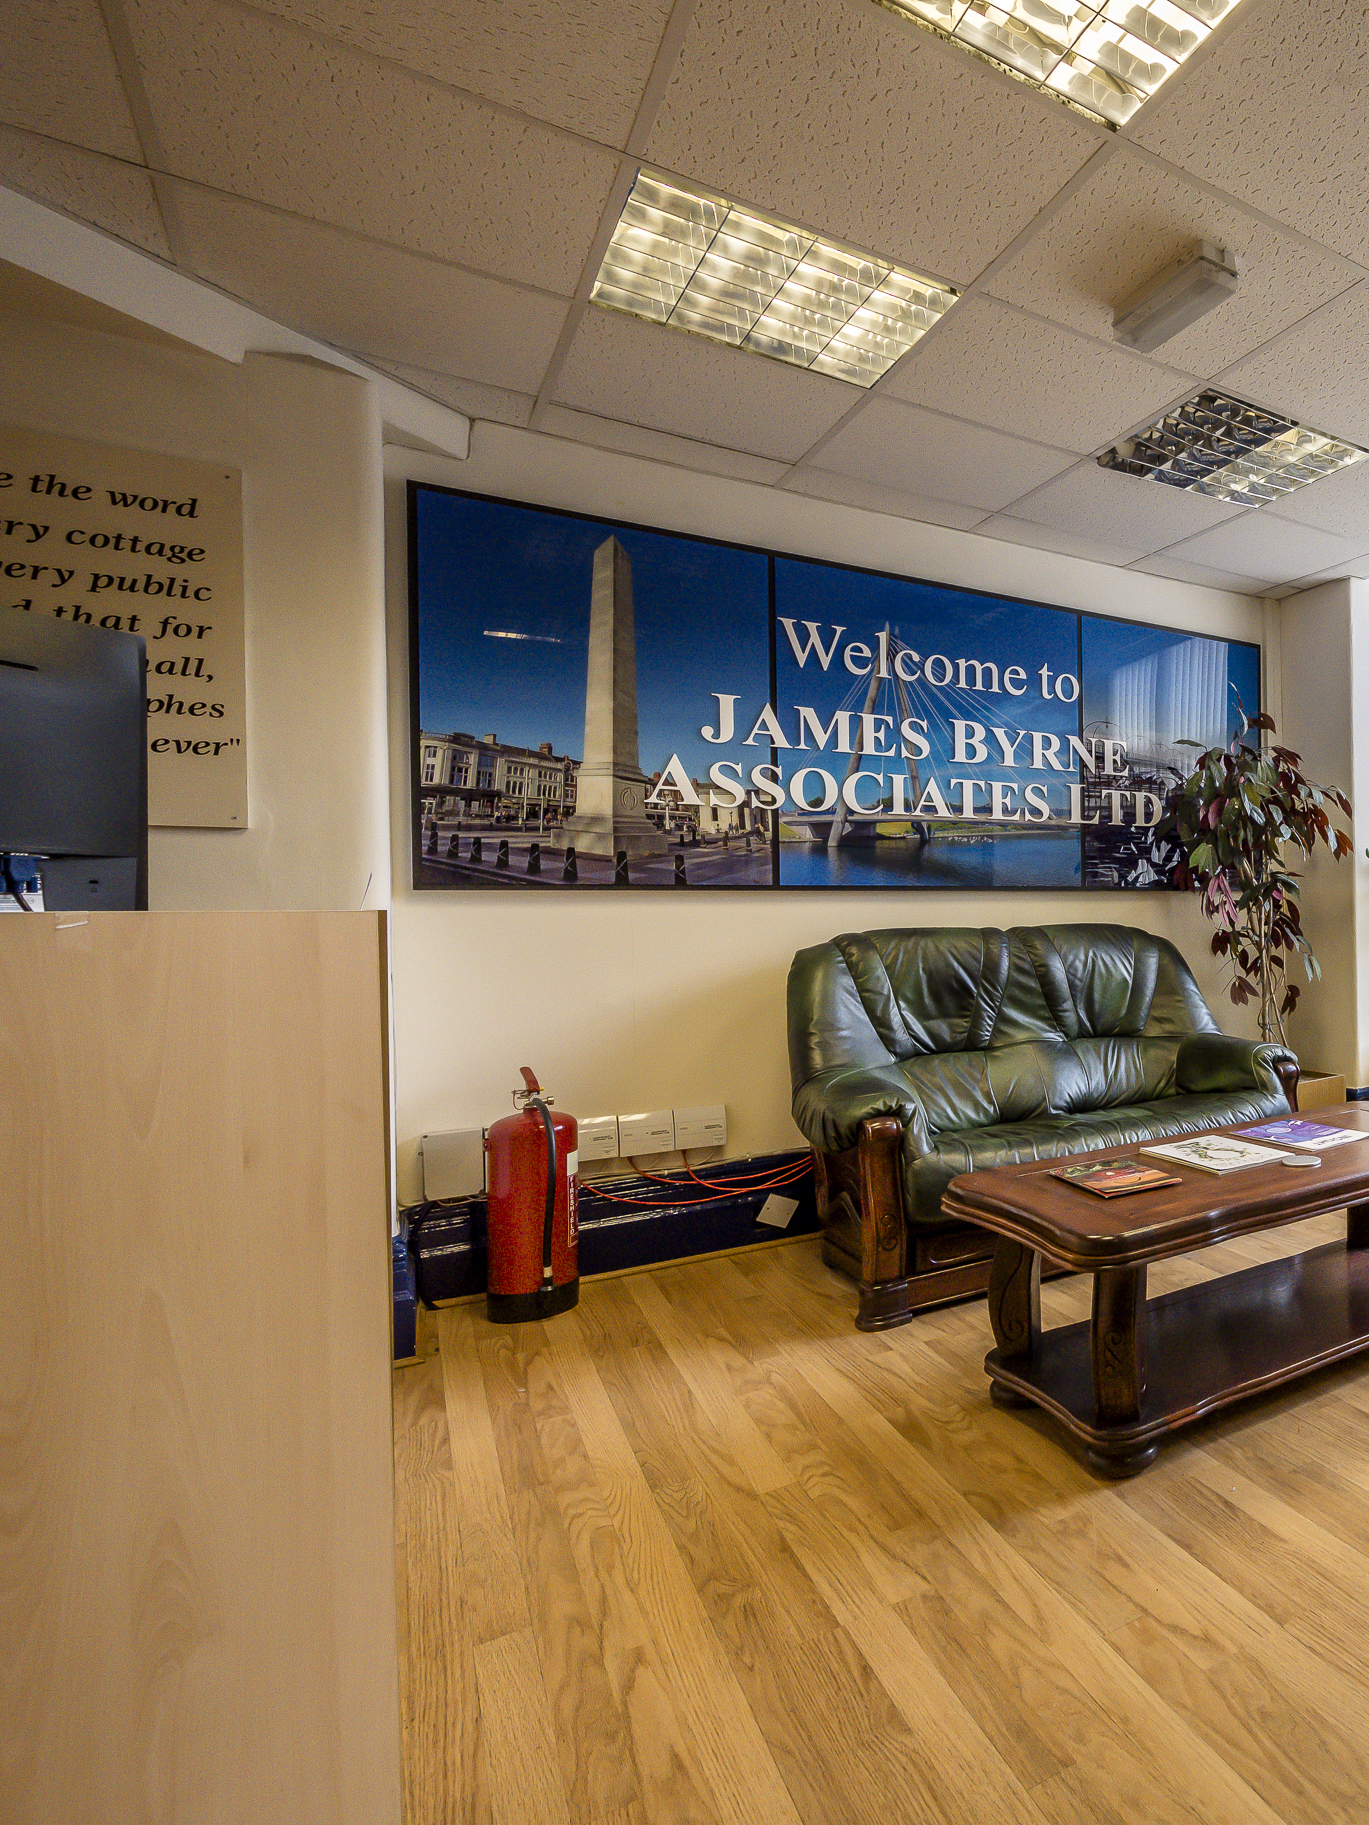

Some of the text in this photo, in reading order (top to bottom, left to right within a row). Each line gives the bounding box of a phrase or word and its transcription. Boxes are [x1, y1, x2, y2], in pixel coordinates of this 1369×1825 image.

[29, 474, 93, 501] the
[105, 490, 199, 519] word
[65, 529, 206, 565] cottage
[86, 573, 212, 602] public
[52, 604, 141, 632] that
[152, 615, 213, 640] for
[777, 616, 1080, 703] Welcome to
[150, 738, 240, 757] ever"
[701, 693, 1129, 777] JAMES BYRNE
[643, 753, 1162, 828] ASSOCIATES LTD
